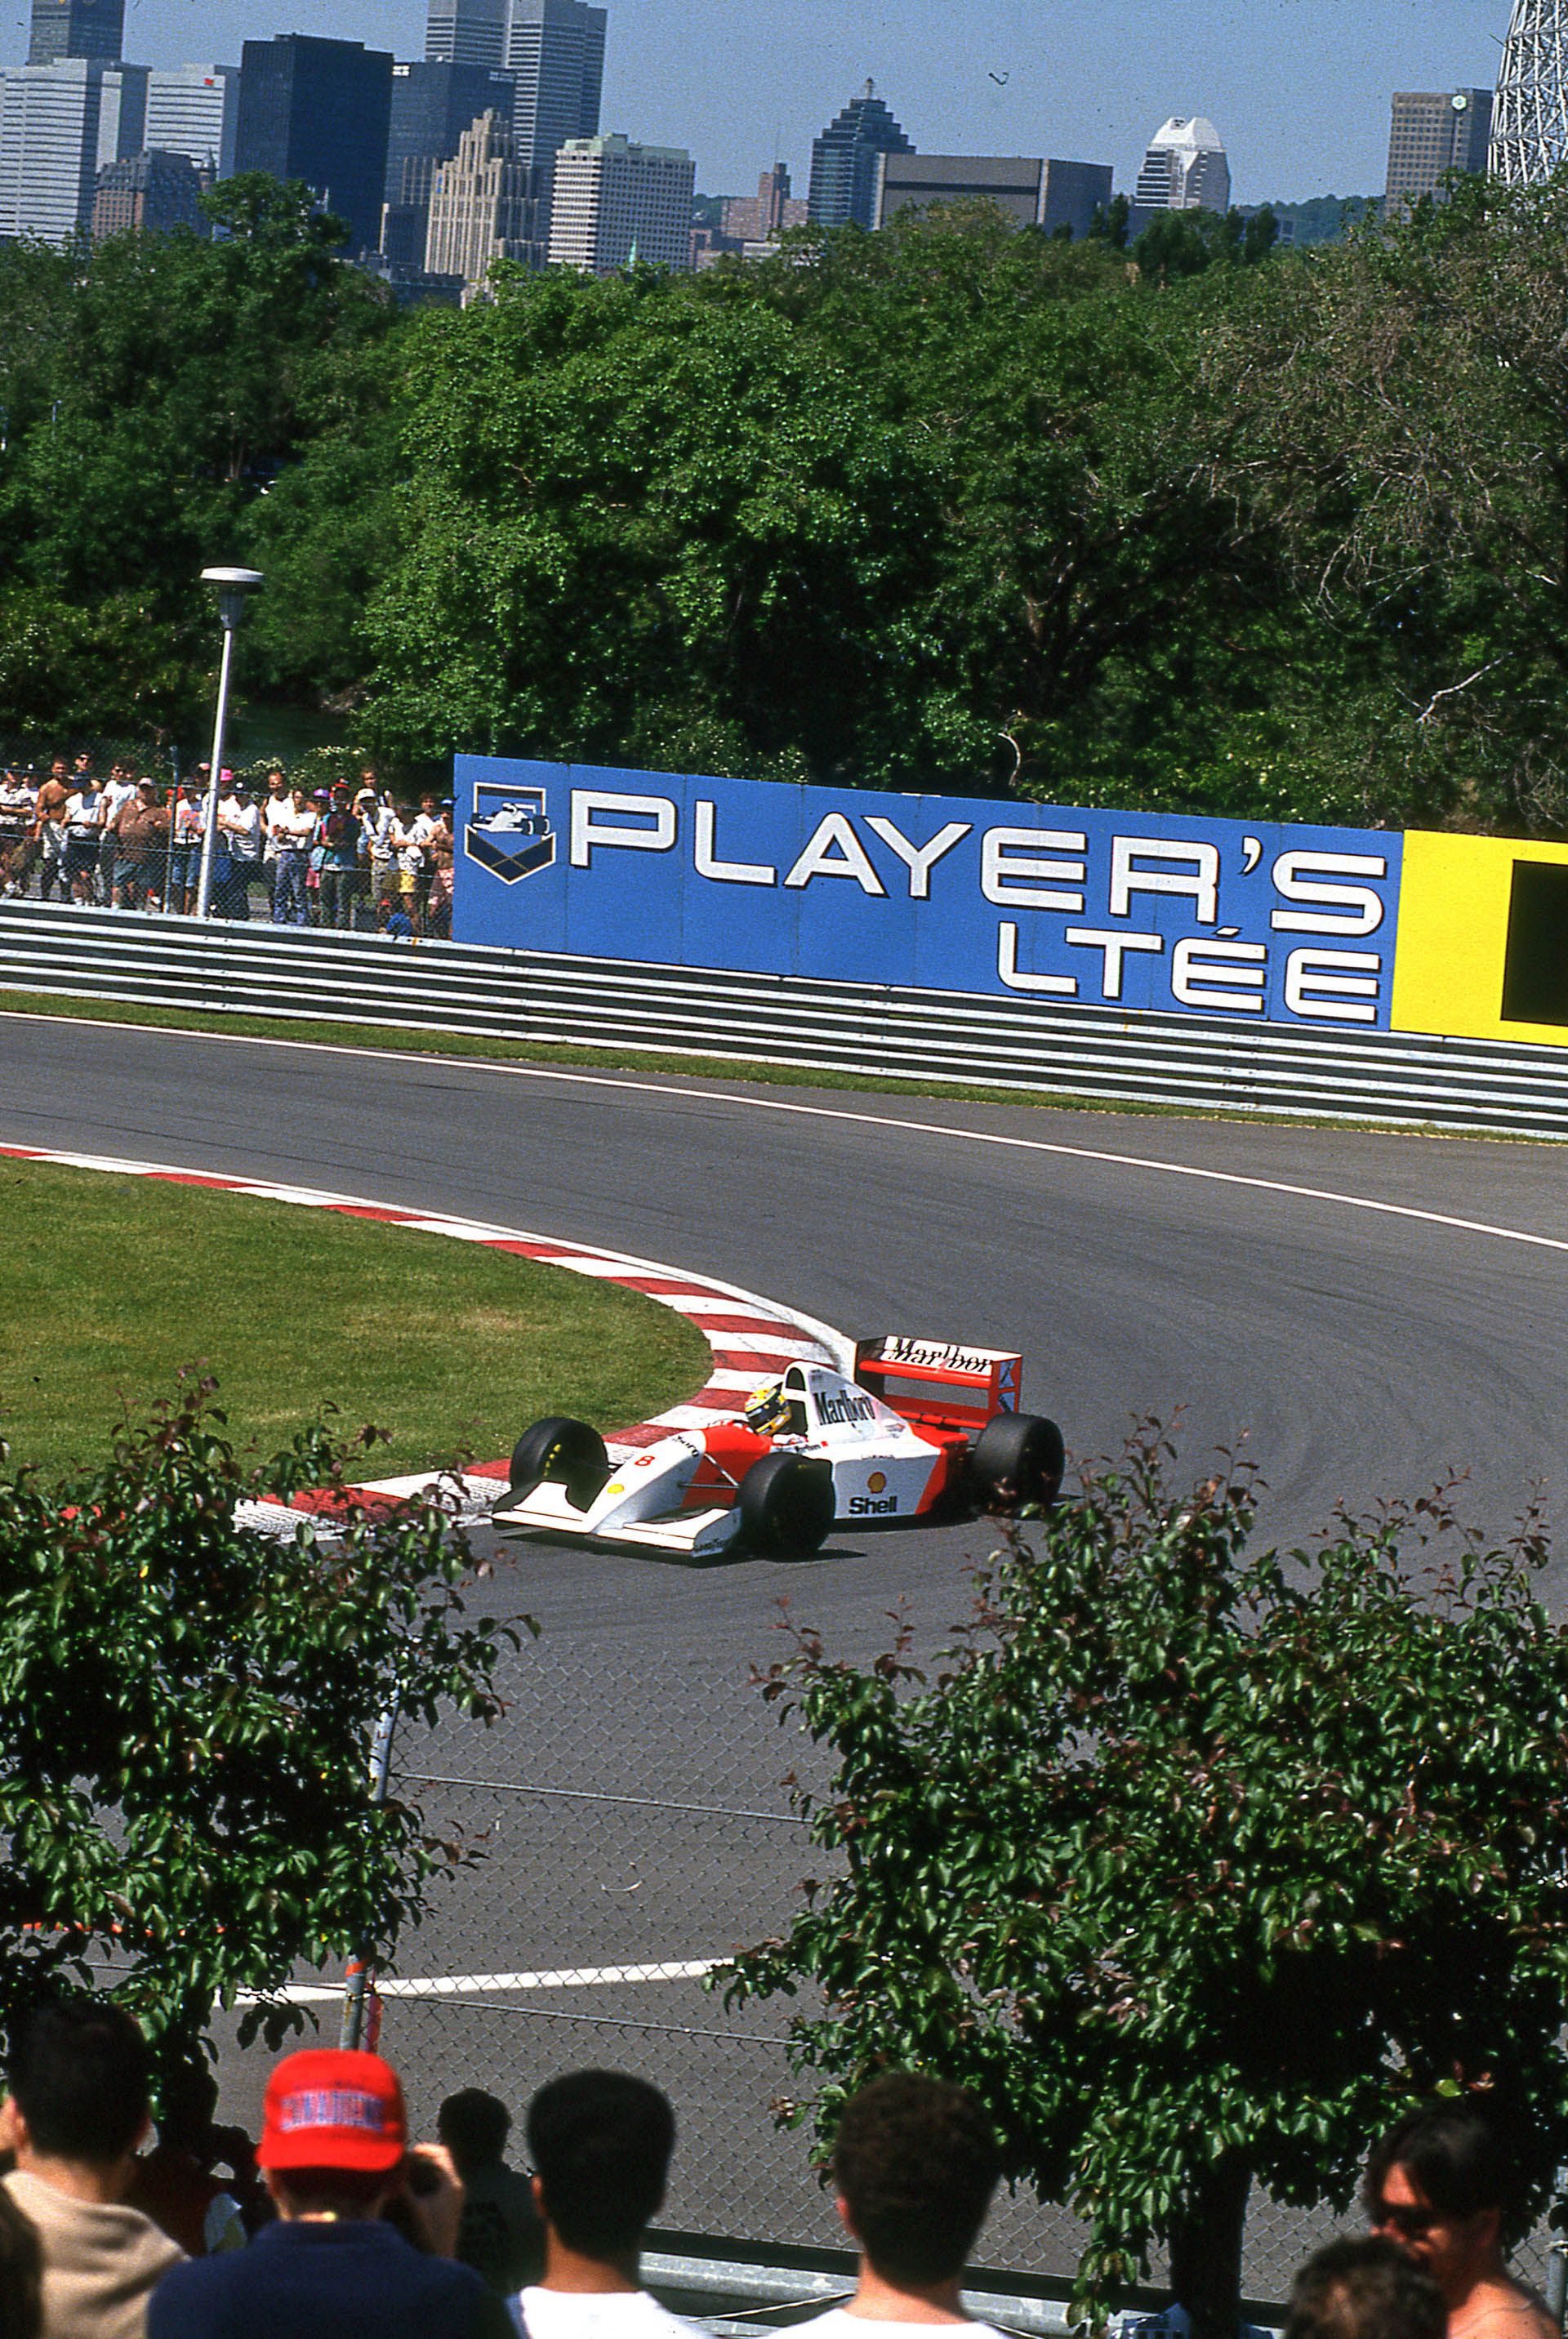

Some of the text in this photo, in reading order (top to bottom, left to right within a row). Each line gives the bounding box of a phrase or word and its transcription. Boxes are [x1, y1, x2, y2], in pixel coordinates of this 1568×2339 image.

[569, 789, 1386, 937] PLAYER'S
[997, 921, 1381, 1022] LTÉE
[813, 1389, 876, 1425] Marlboro
[634, 1455, 655, 1467] 8
[849, 1495, 898, 1515] Shell
